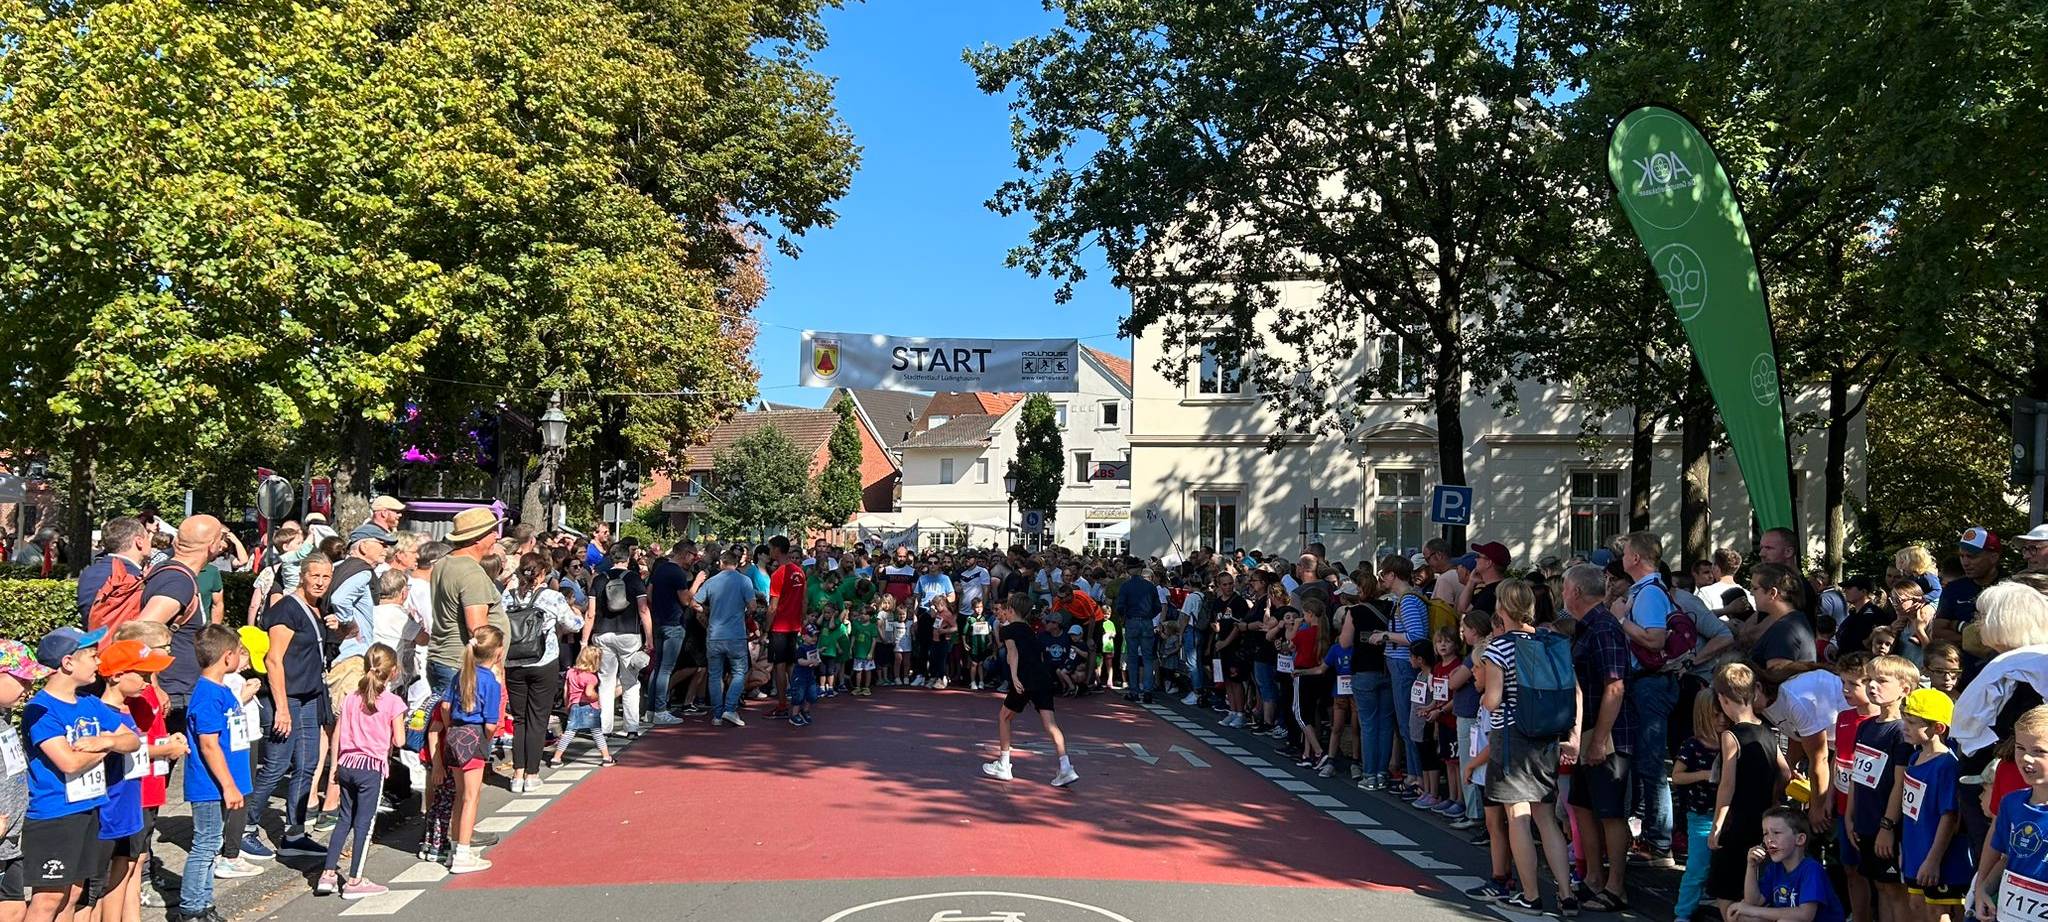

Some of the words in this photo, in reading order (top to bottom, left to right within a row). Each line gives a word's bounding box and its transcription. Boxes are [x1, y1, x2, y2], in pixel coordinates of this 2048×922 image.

[892, 346, 992, 373] START
[1093, 469, 1115, 478] LBS
[1440, 491, 1463, 519] P
[2005, 891, 2048, 920] 7172
